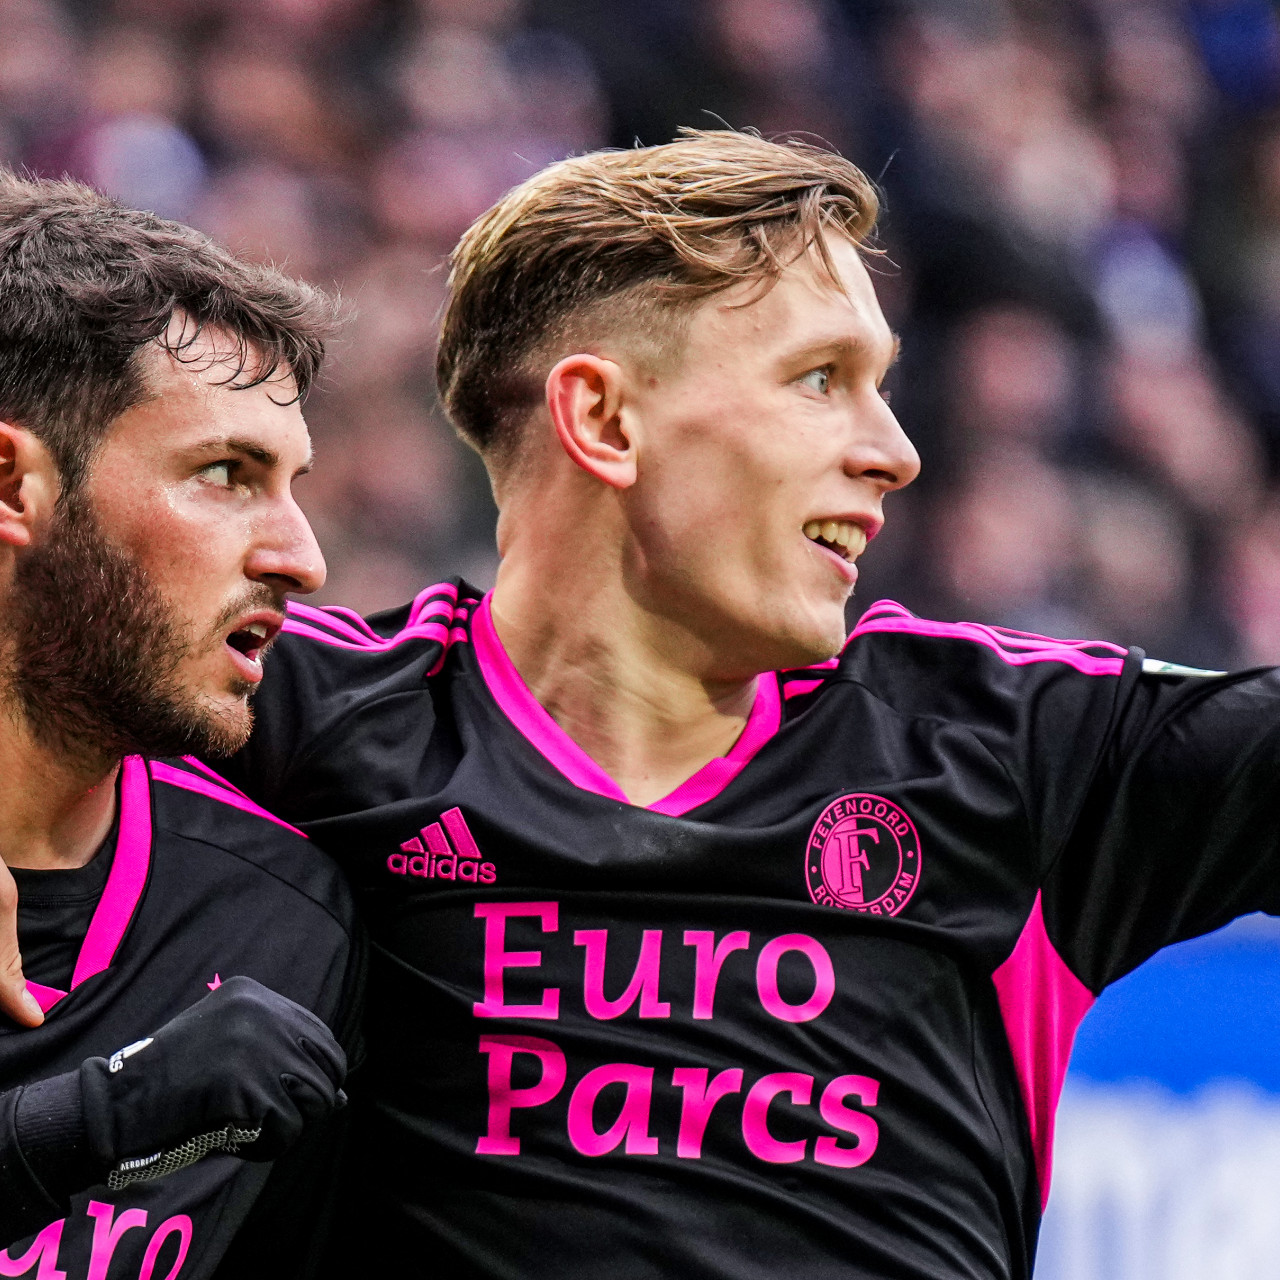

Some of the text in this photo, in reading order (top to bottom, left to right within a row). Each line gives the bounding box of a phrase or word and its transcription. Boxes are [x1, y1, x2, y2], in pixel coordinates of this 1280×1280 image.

[812, 799, 910, 849] FEYENOORD
[386, 851, 497, 885] adidas
[834, 827, 880, 896] F
[472, 900, 836, 1023] Euro
[473, 1033, 881, 1169] Parcs
